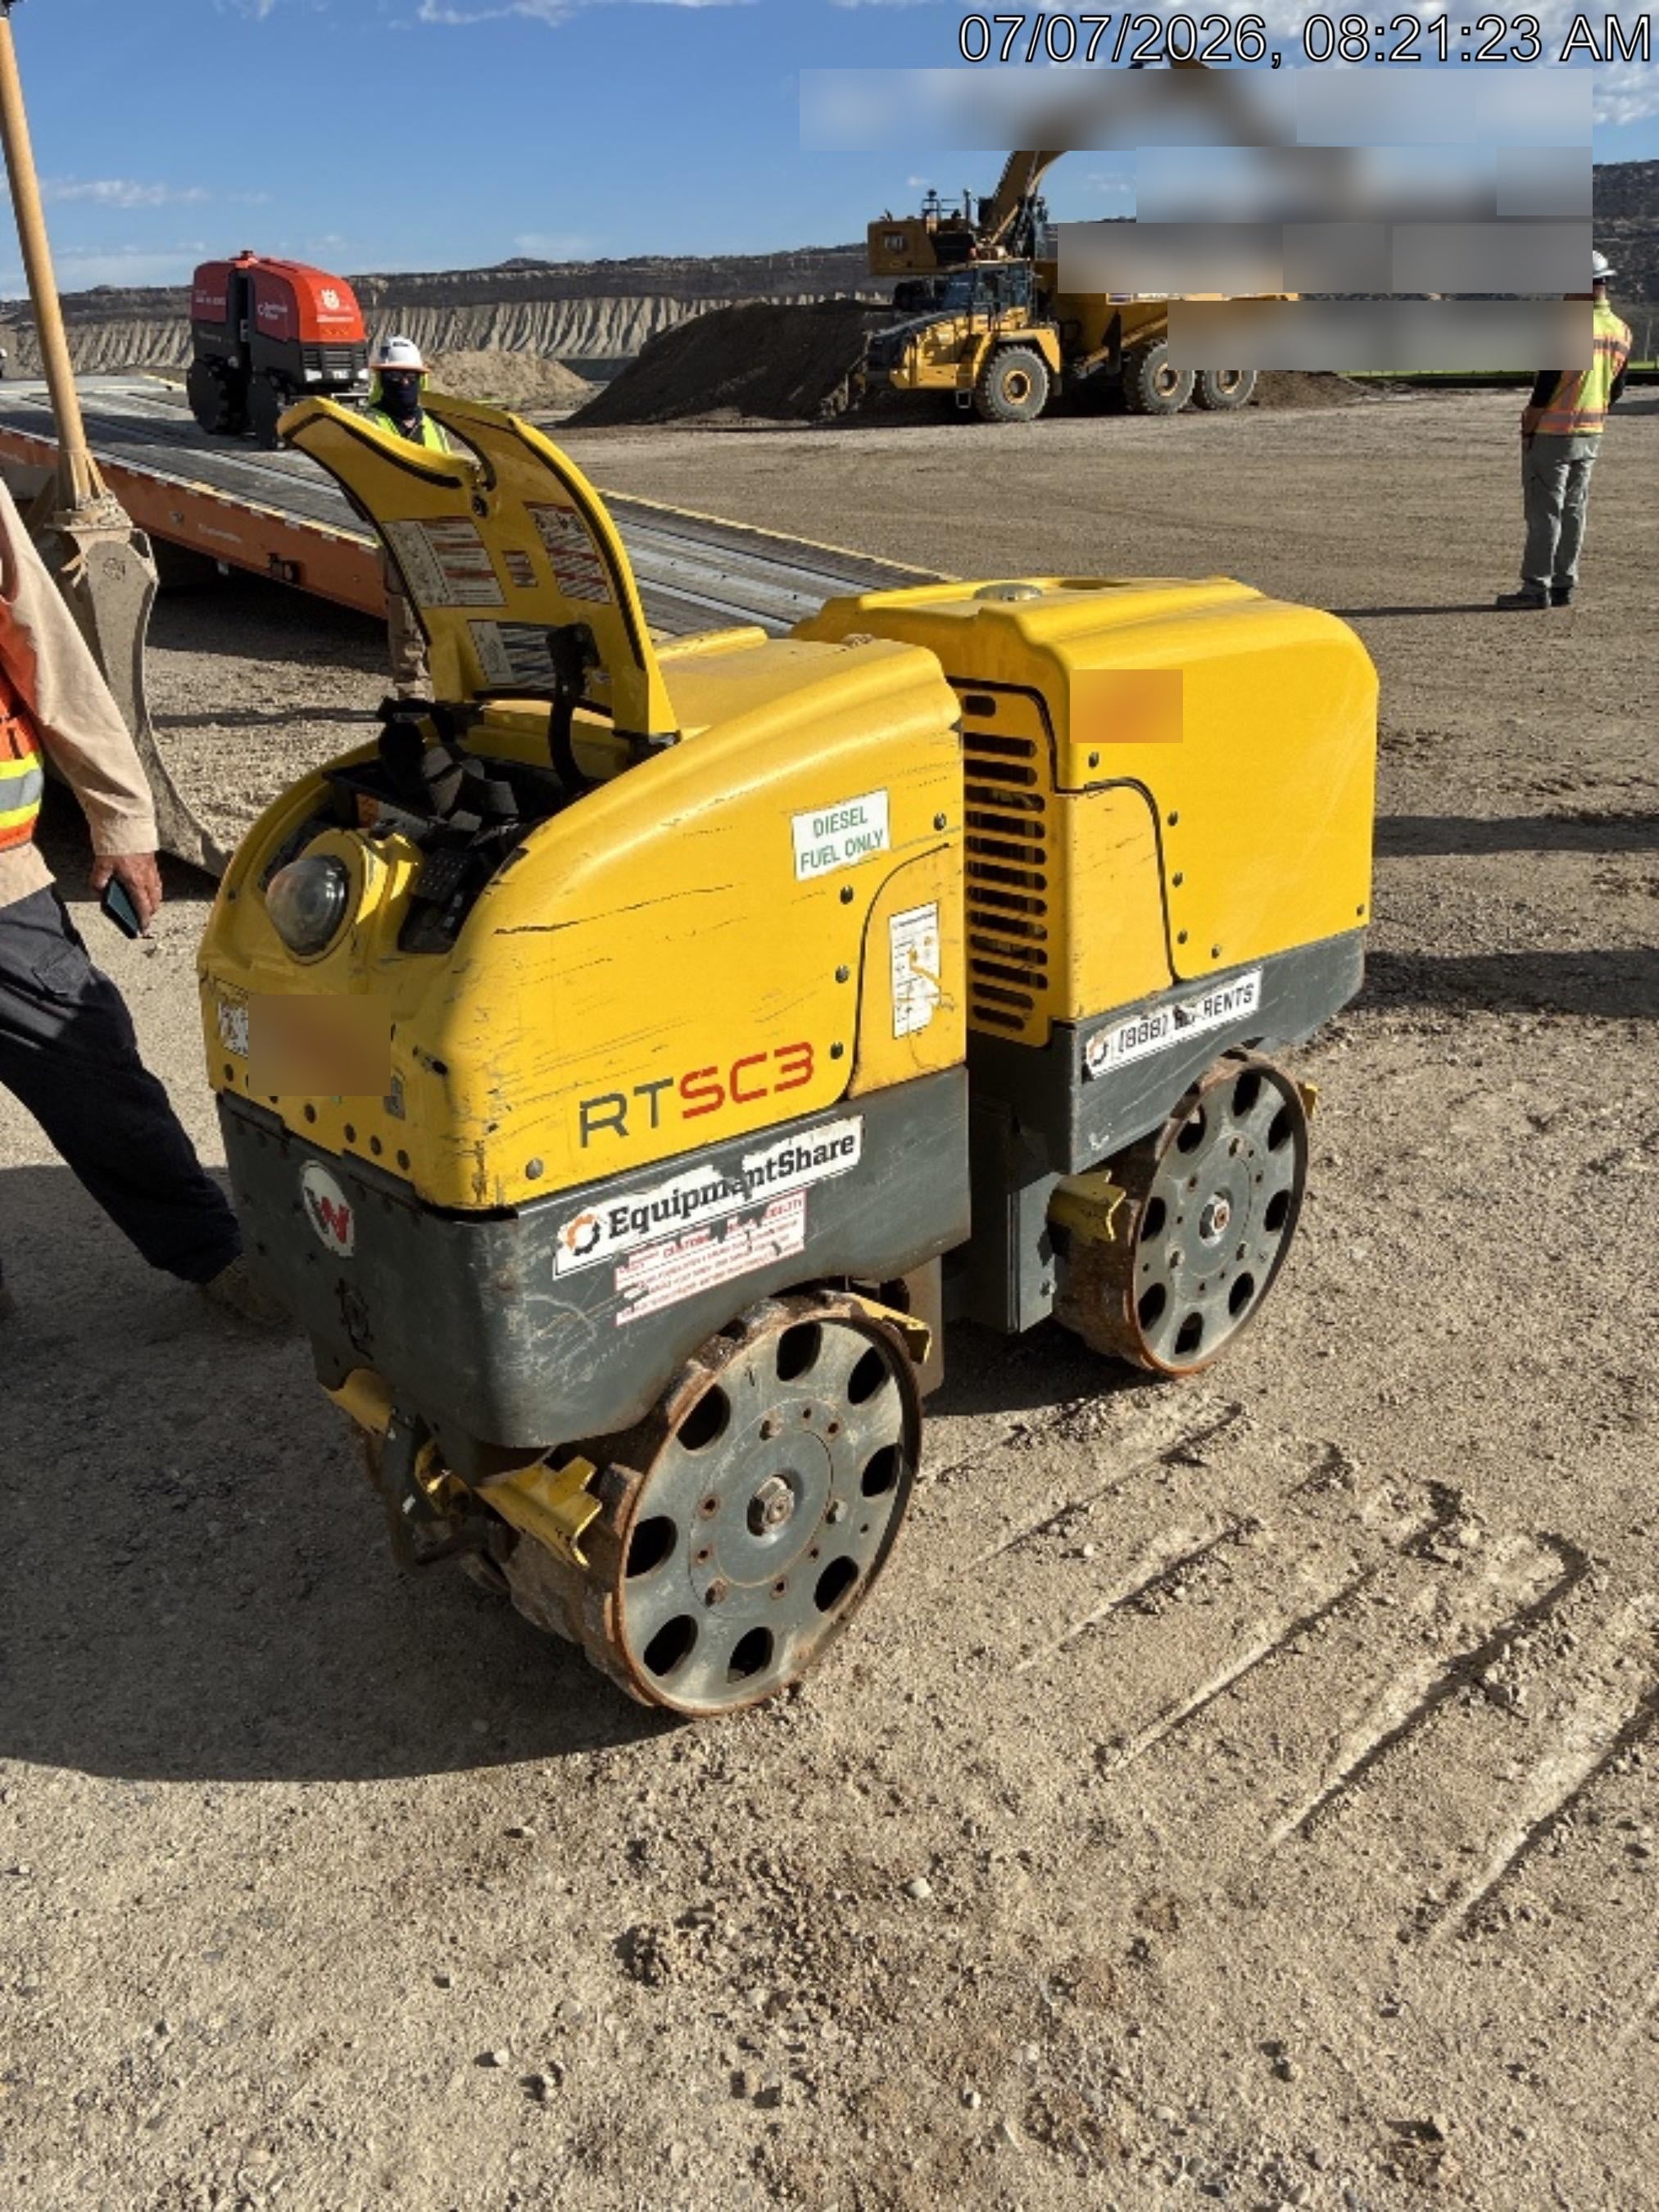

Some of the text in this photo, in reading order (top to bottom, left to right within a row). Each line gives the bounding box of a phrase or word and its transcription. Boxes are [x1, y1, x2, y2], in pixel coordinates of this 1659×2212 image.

[812, 805, 868, 839] DIESEL
[800, 828, 884, 873] FUEL ONLY
[1203, 982, 1254, 1018] RENTS
